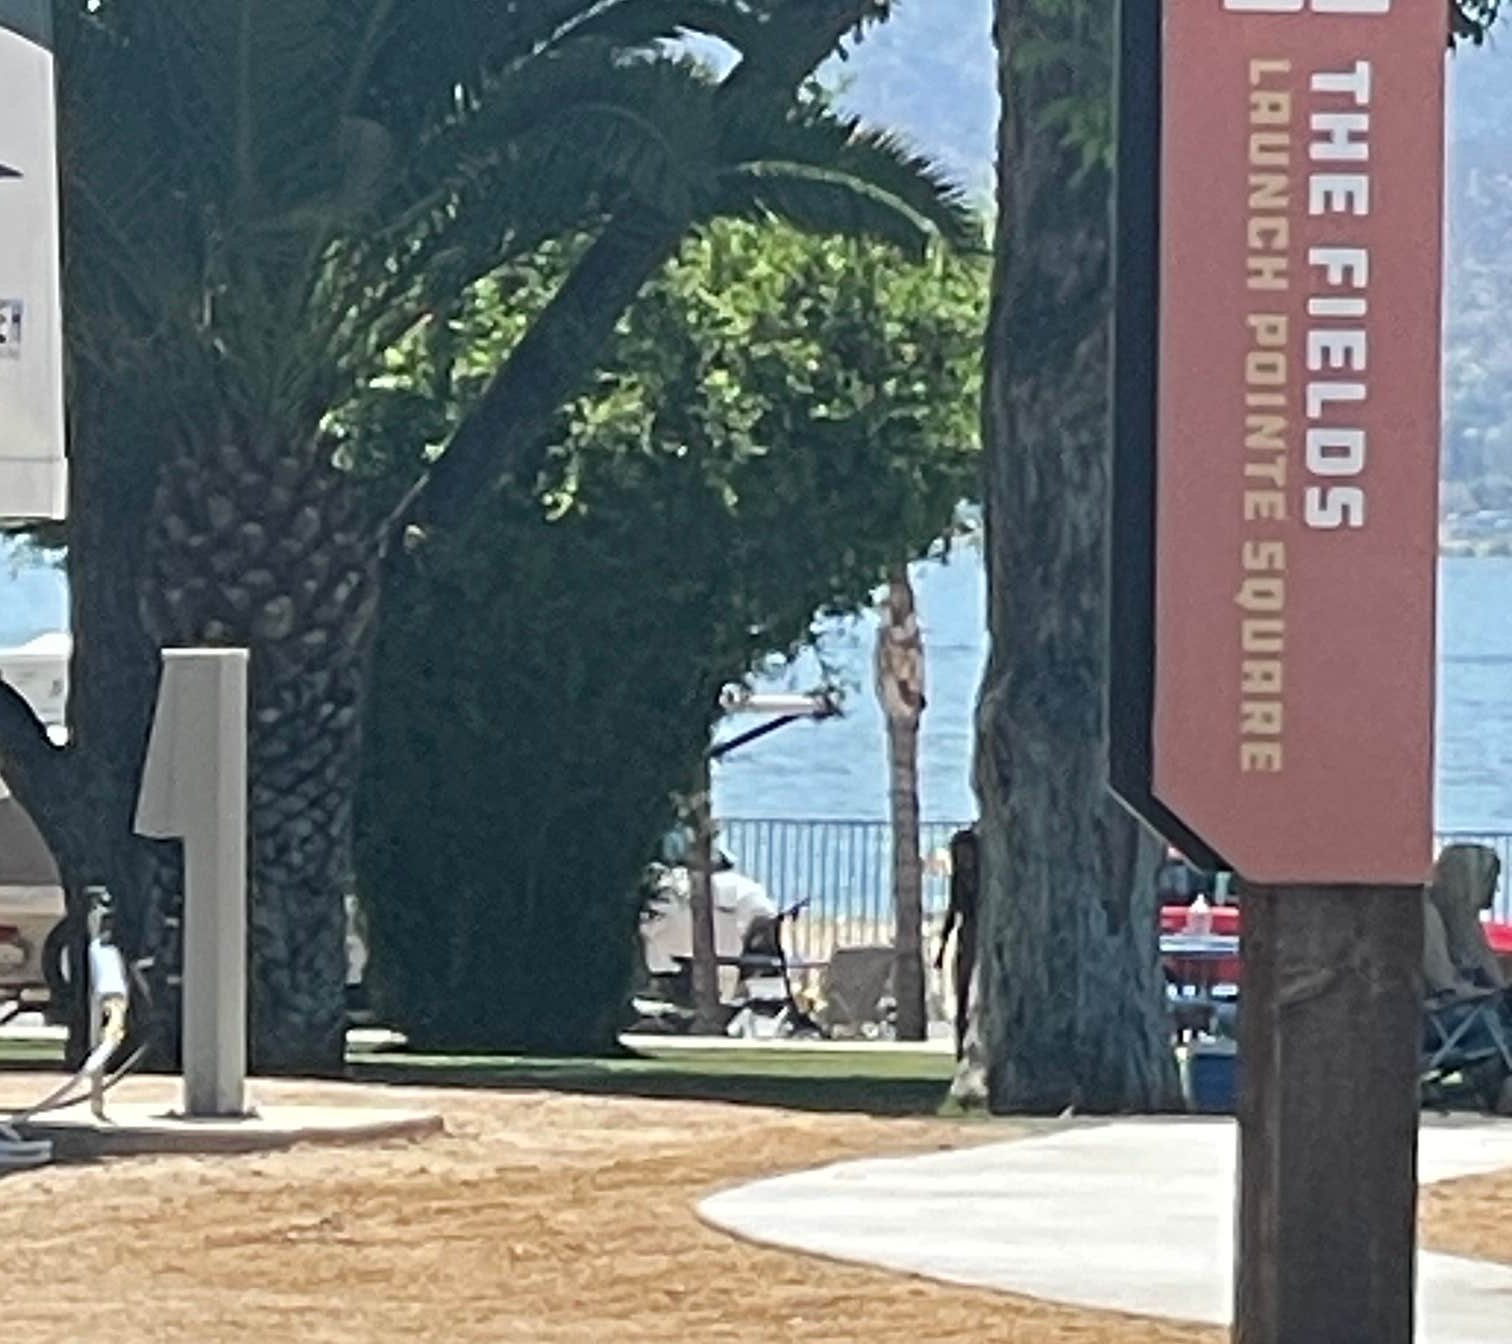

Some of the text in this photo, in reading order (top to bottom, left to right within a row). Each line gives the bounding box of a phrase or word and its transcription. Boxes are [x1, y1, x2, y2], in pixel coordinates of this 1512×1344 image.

[1234, 59, 1292, 773] LAUNCH POINTE SQUARE
[1305, 60, 1372, 529] THE FIELDS
